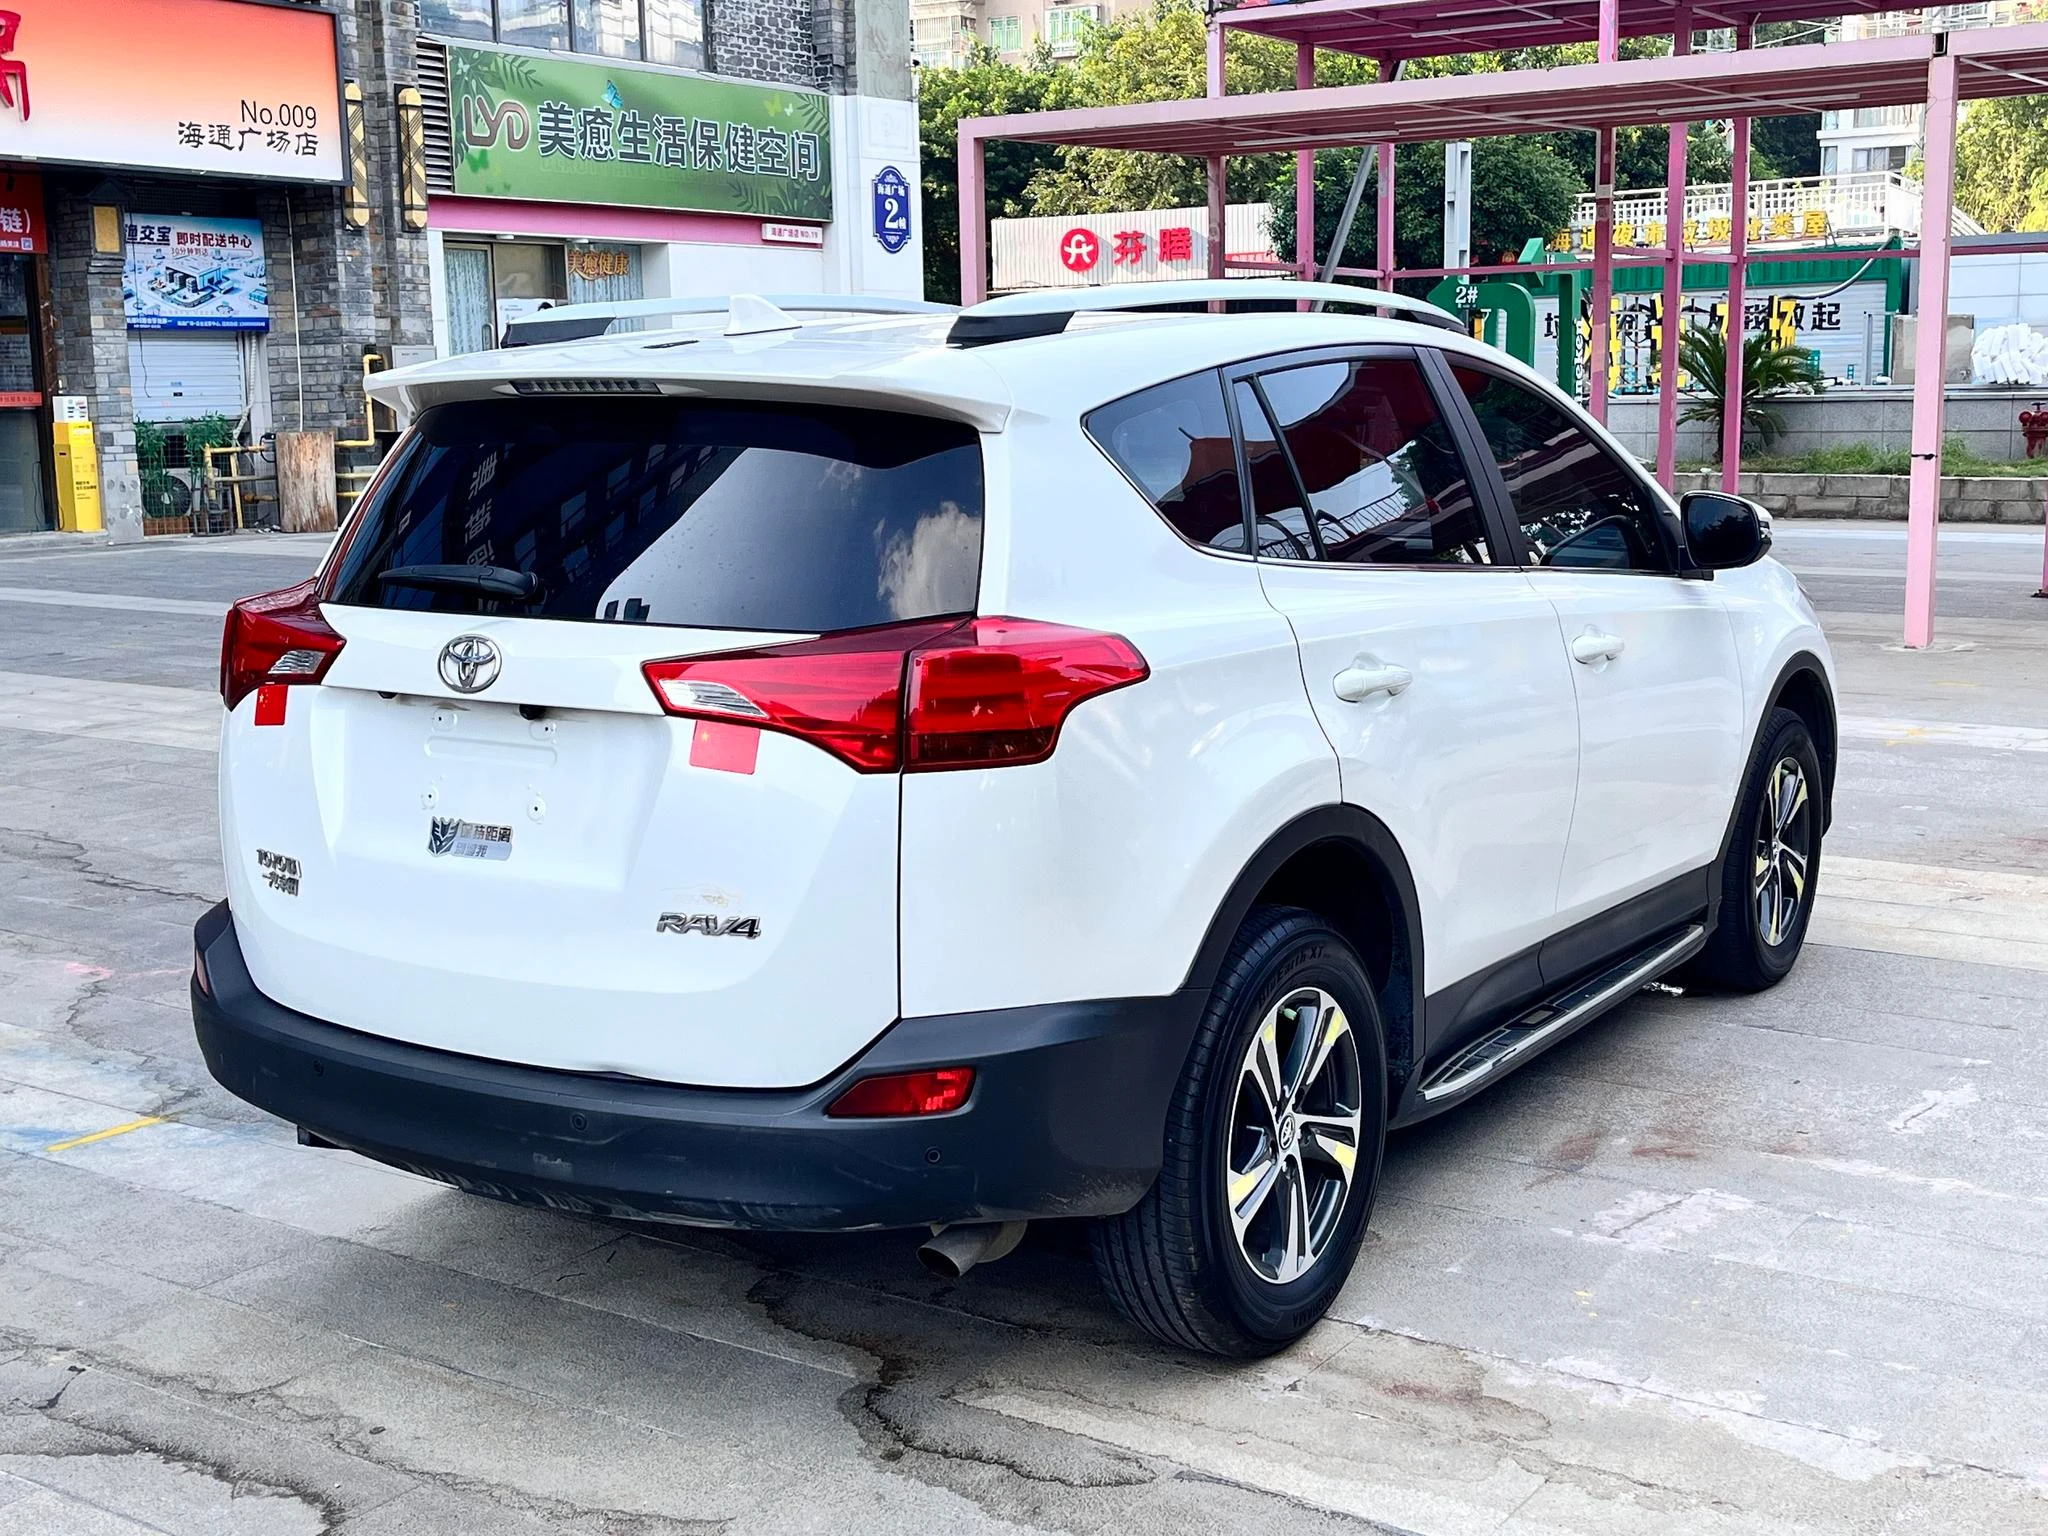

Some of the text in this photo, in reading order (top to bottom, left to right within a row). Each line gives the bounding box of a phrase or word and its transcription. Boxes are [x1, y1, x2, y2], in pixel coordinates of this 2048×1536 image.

[240, 99, 317, 129] No.009
[178, 121, 319, 156] 海通广场店
[536, 100, 823, 182] 美癒生活保健空间
[176, 231, 253, 248] 即时配送中心
[1113, 227, 1192, 265] 芬腾
[1455, 286, 1479, 304] 2#
[256, 848, 302, 878] TOYOTA
[656, 911, 761, 940] RAV4
